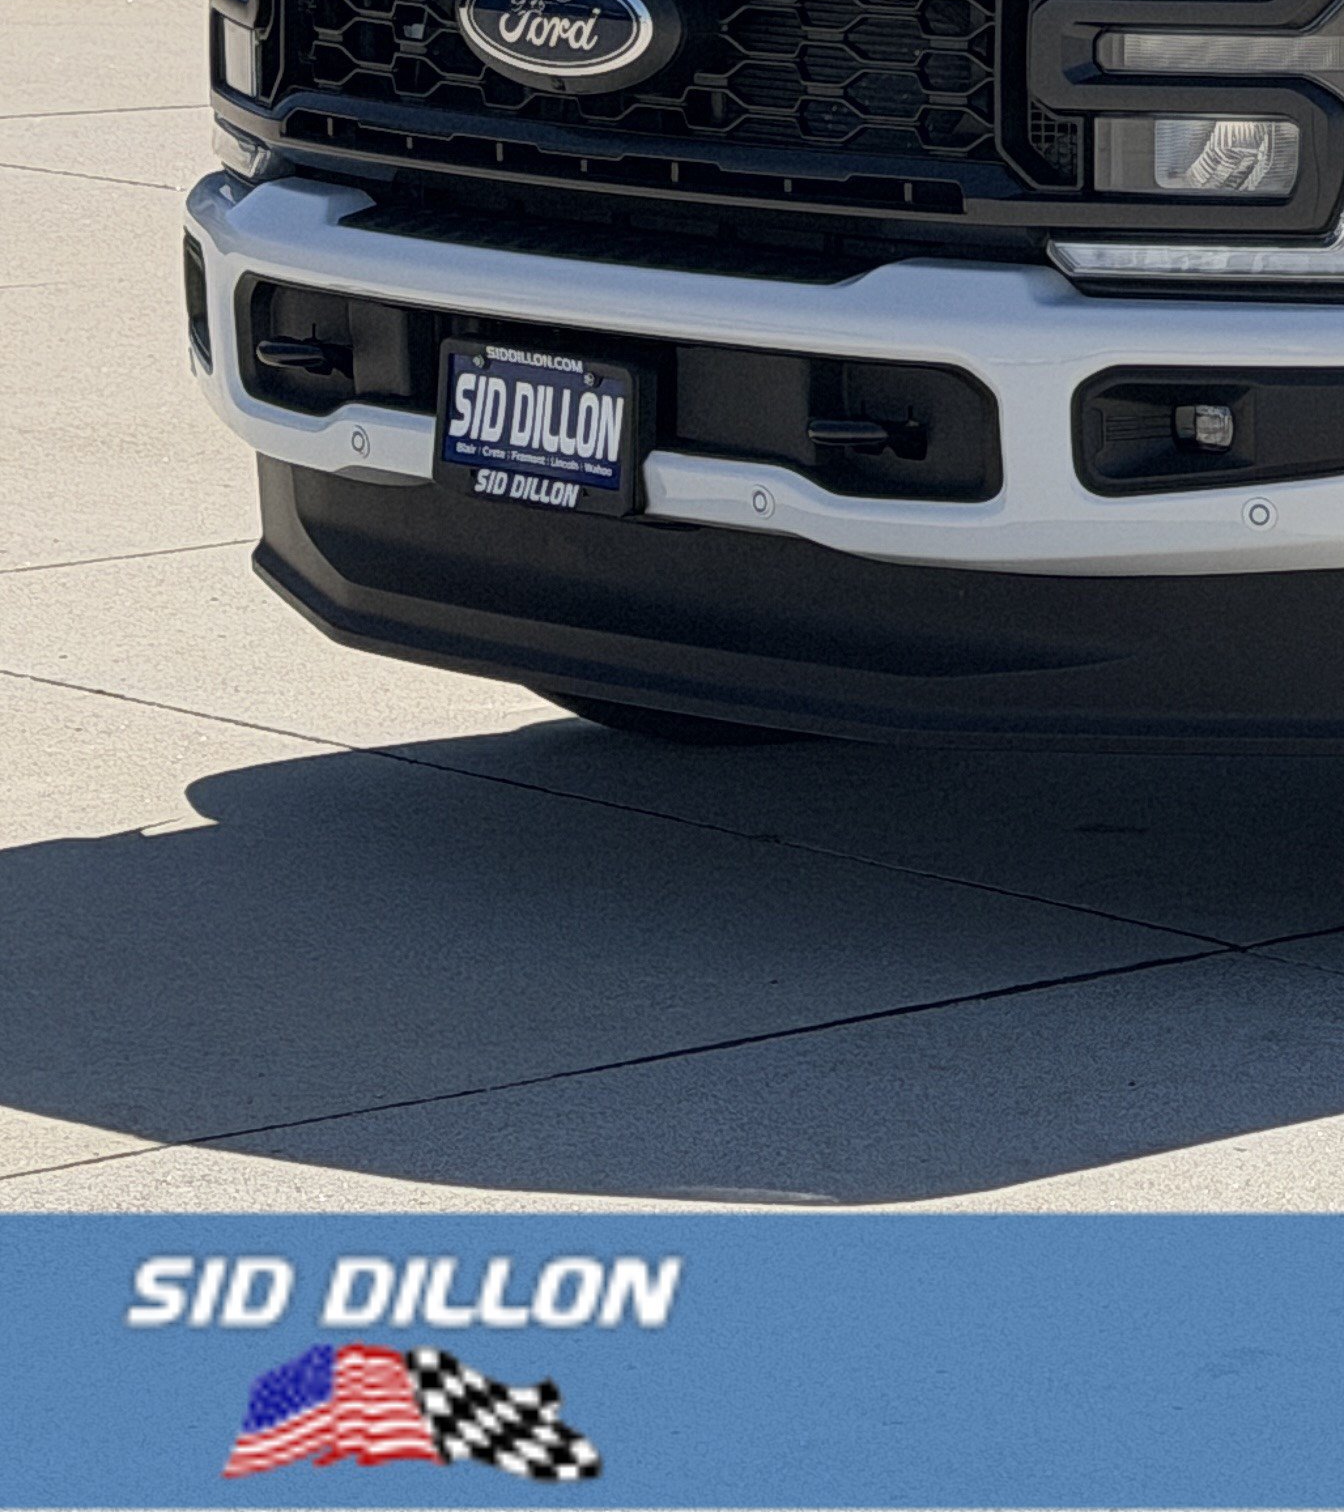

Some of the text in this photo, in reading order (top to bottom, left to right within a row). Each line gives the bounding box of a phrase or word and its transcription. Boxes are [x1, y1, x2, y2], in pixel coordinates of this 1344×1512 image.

[485, 345, 584, 374] SIDDILLON.COM
[449, 373, 625, 463] SID DILLON
[474, 468, 580, 509] SID DILLON
